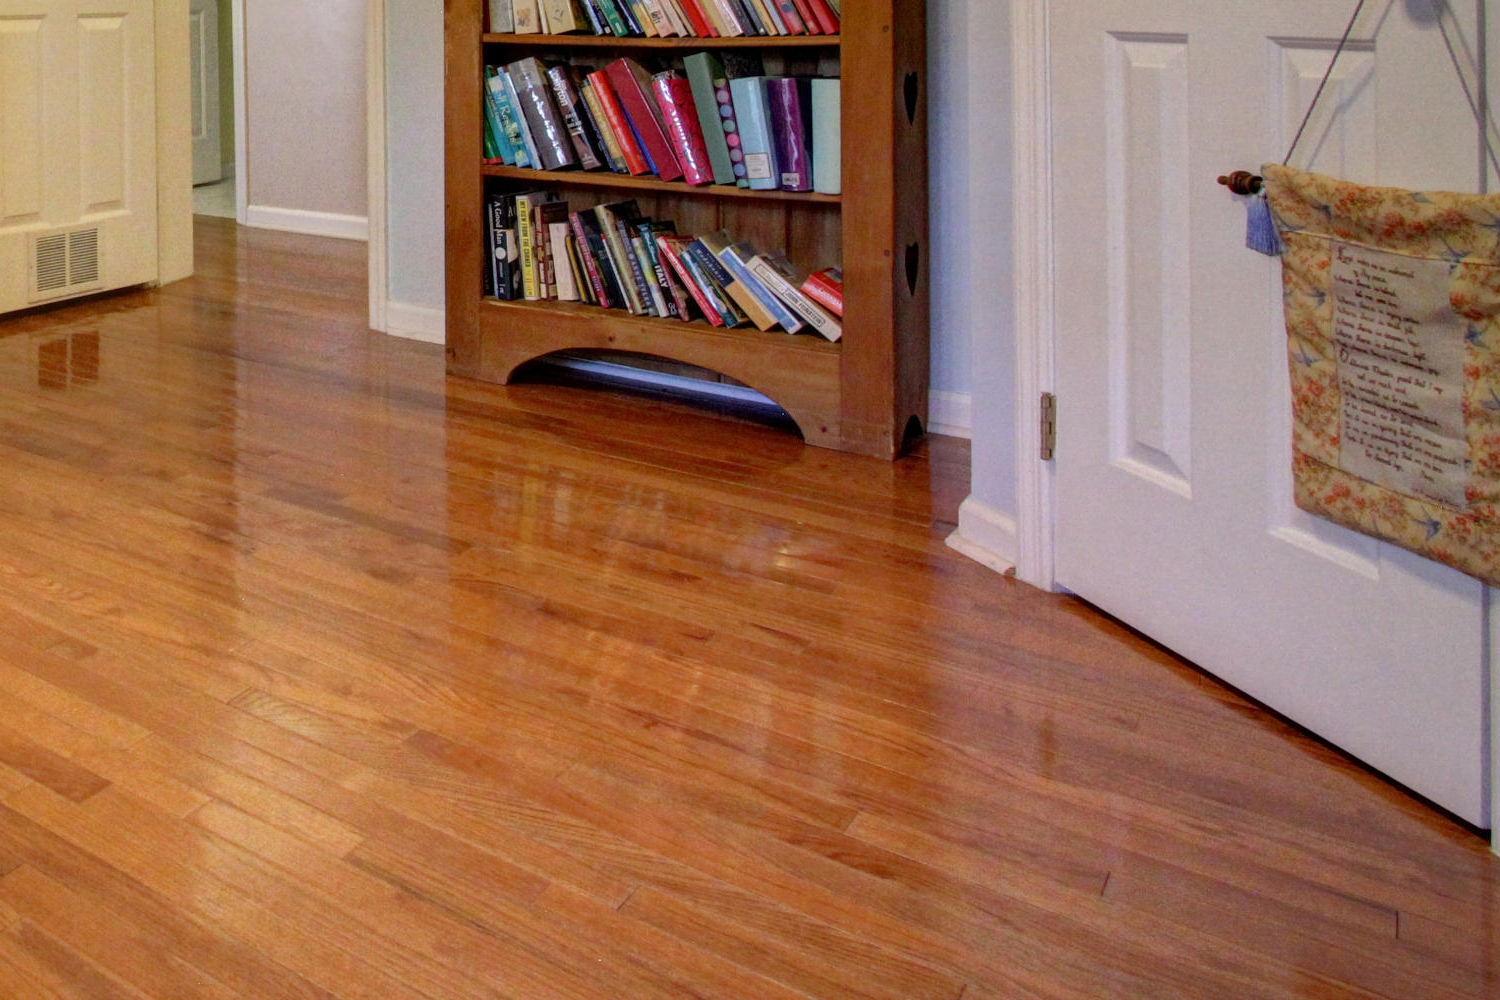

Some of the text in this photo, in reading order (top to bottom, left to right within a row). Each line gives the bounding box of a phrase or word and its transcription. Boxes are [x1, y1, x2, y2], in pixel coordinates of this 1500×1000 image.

[494, 208, 503, 228] Good
[522, 238, 530, 247] THE
[654, 264, 669, 288] ITALY
